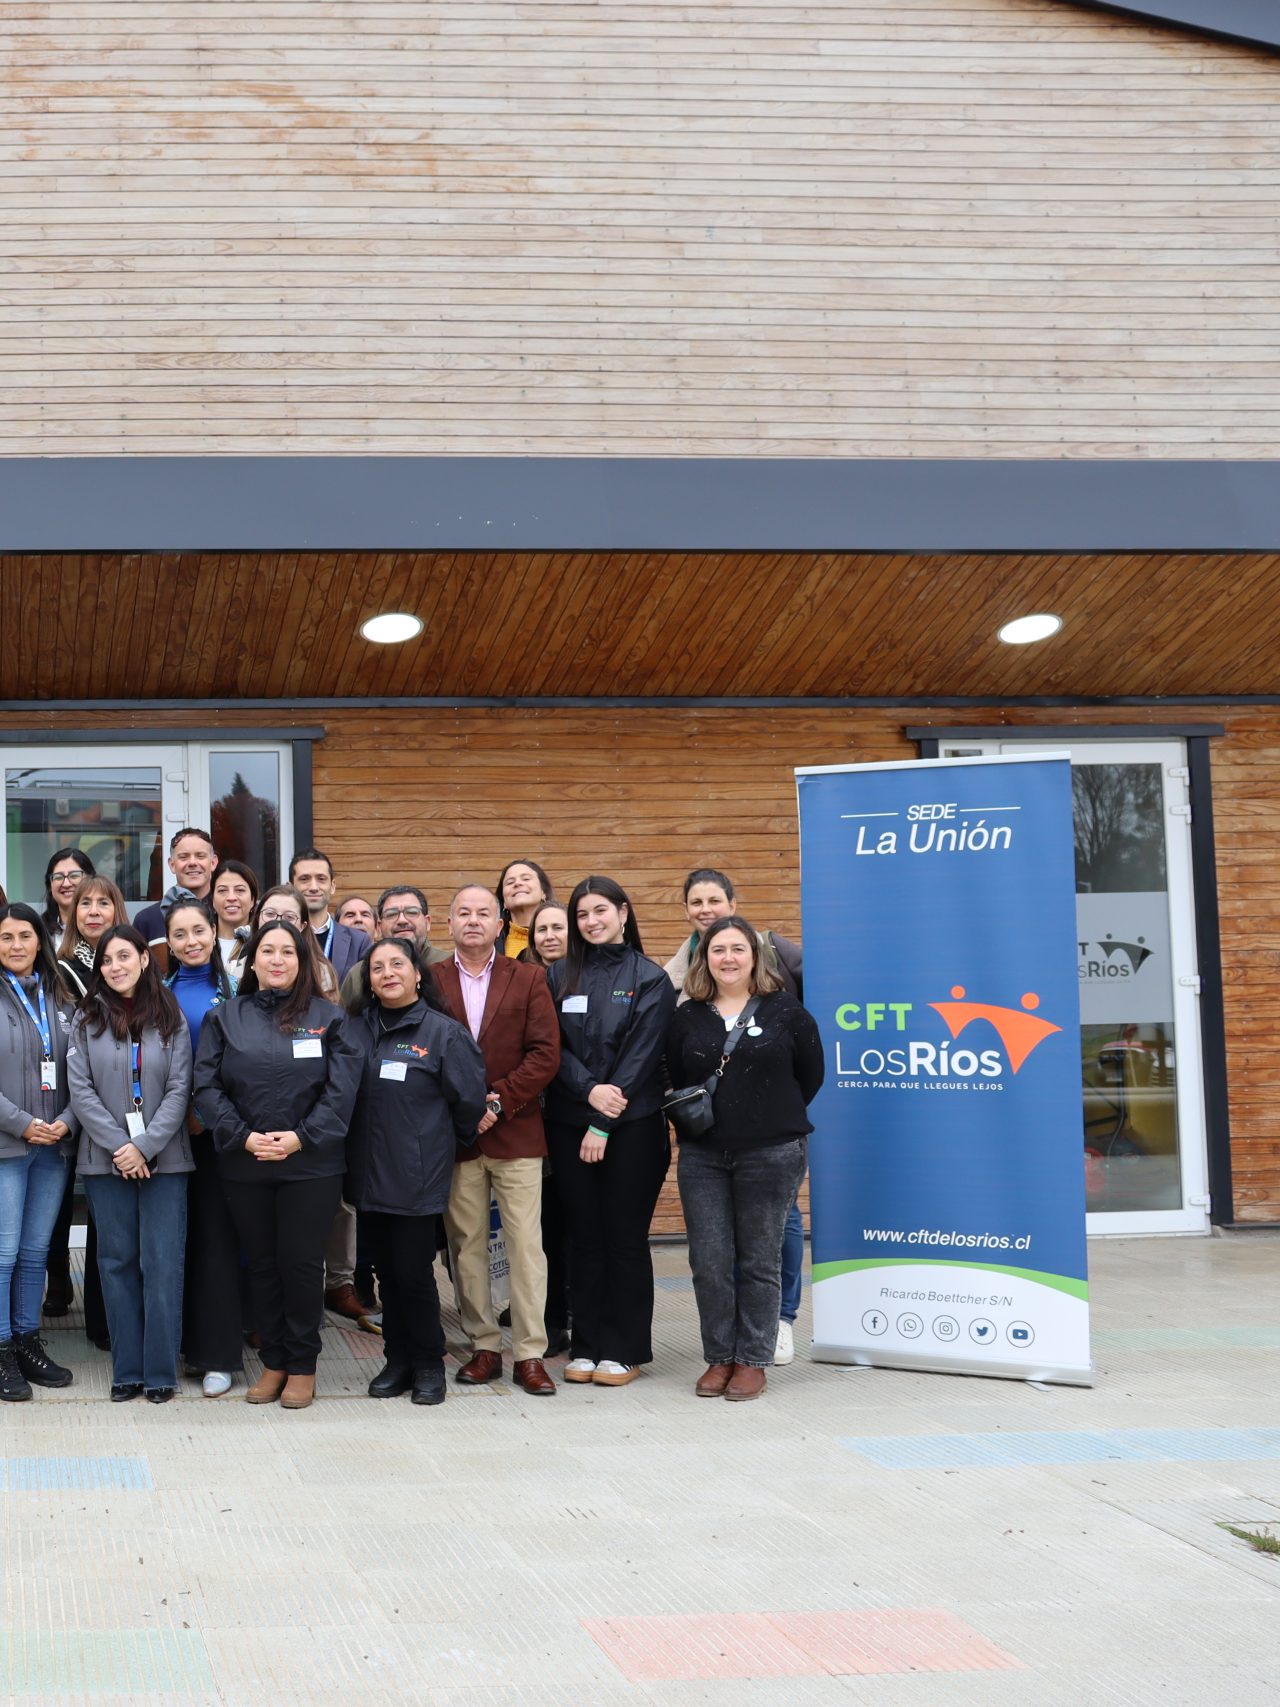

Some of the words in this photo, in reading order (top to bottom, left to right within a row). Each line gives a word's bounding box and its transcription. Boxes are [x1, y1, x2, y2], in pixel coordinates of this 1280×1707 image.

[907, 803, 958, 821] SEDE
[855, 826, 897, 855] La
[909, 819, 1013, 853] Unión
[1077, 960, 1130, 978] sRíos
[835, 1003, 912, 1031] CFT
[836, 1041, 1003, 1077] LosRíos
[924, 1082, 969, 1090] LLEGUES
[972, 1083, 1004, 1091] LEJOS
[863, 1227, 1031, 1251] www.cftdelosrios.cl
[880, 1287, 926, 1301] Ricardo
[927, 1291, 987, 1305] Boettcher
[989, 1295, 1013, 1307] S/N
